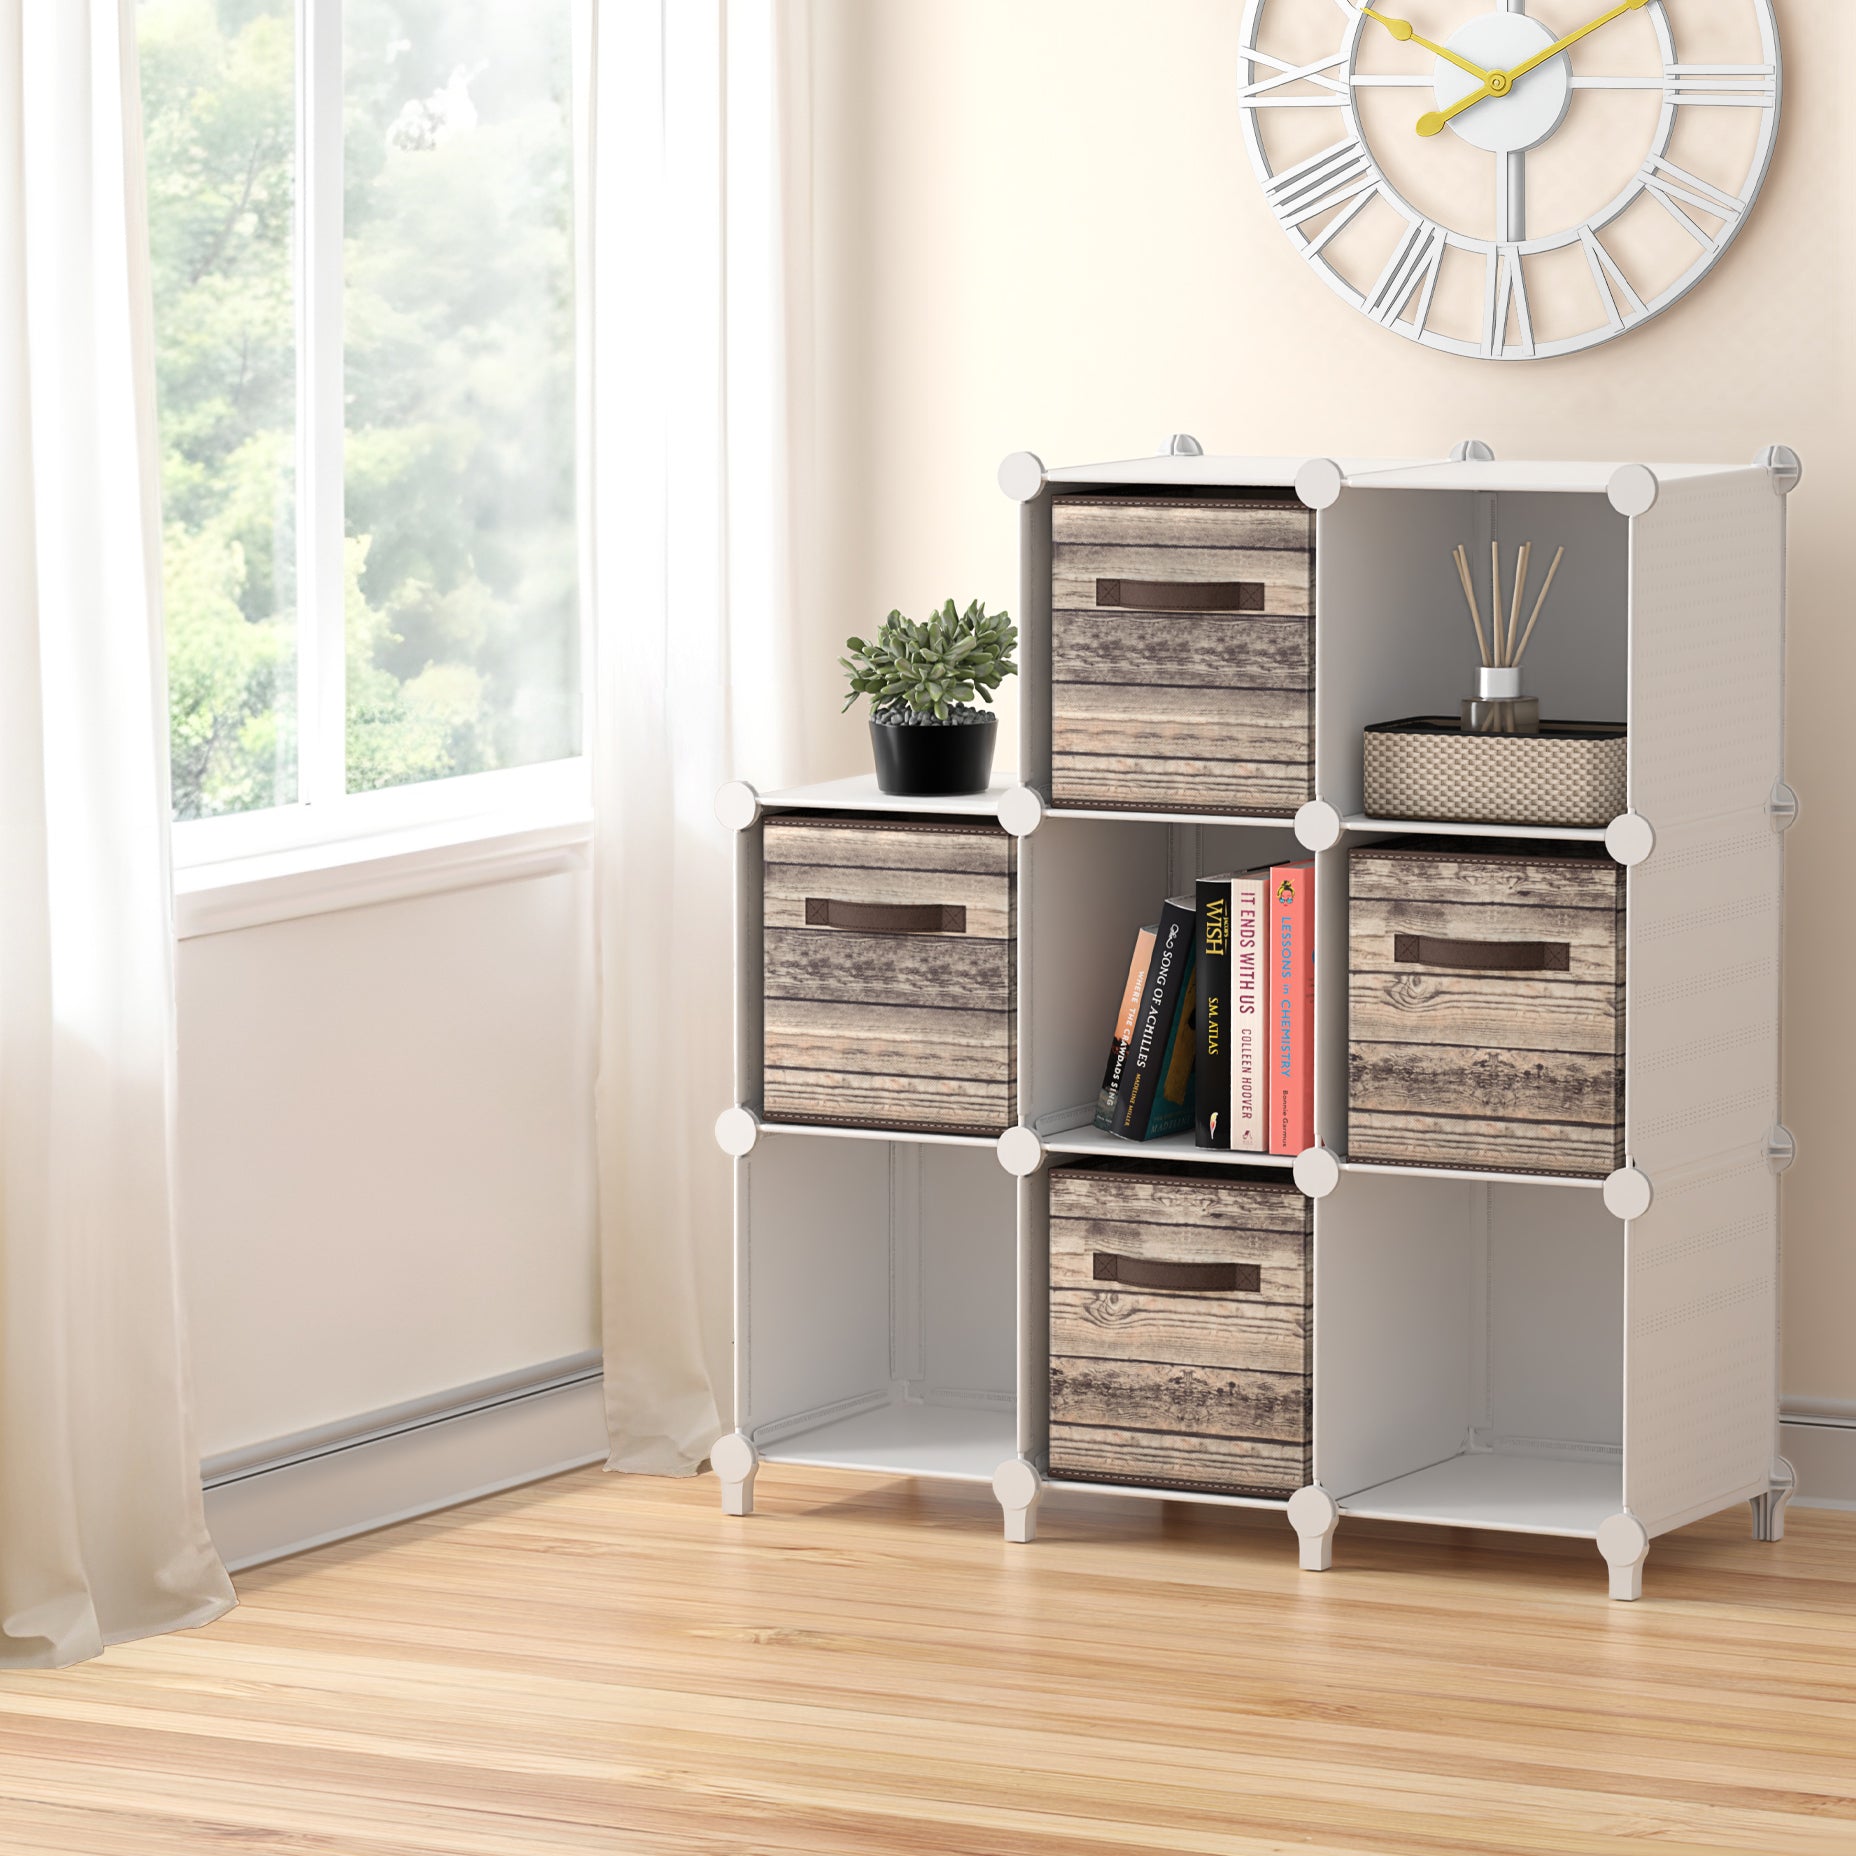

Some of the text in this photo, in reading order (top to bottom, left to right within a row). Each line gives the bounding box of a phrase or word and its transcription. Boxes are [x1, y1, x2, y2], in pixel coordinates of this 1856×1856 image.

[1205, 898, 1225, 956] WISH
[1239, 892, 1255, 1014] IT ENDS WITH US
[1151, 987, 1164, 1006] OF
[1156, 951, 1174, 986] SONG
[1280, 916, 1292, 1078] LESSONS in CHEMISTRY
[1106, 970, 1145, 1106] WHERE THE CRAWDADS SING
[1135, 1005, 1158, 1069] ACHILLES
[1208, 1020, 1219, 1055] ATLAS
[1124, 1073, 1141, 1127] MADELINE MILLER
[1241, 1028, 1252, 1119] COLLEEN HOOVER
[1281, 1117, 1289, 1148] Garmus
